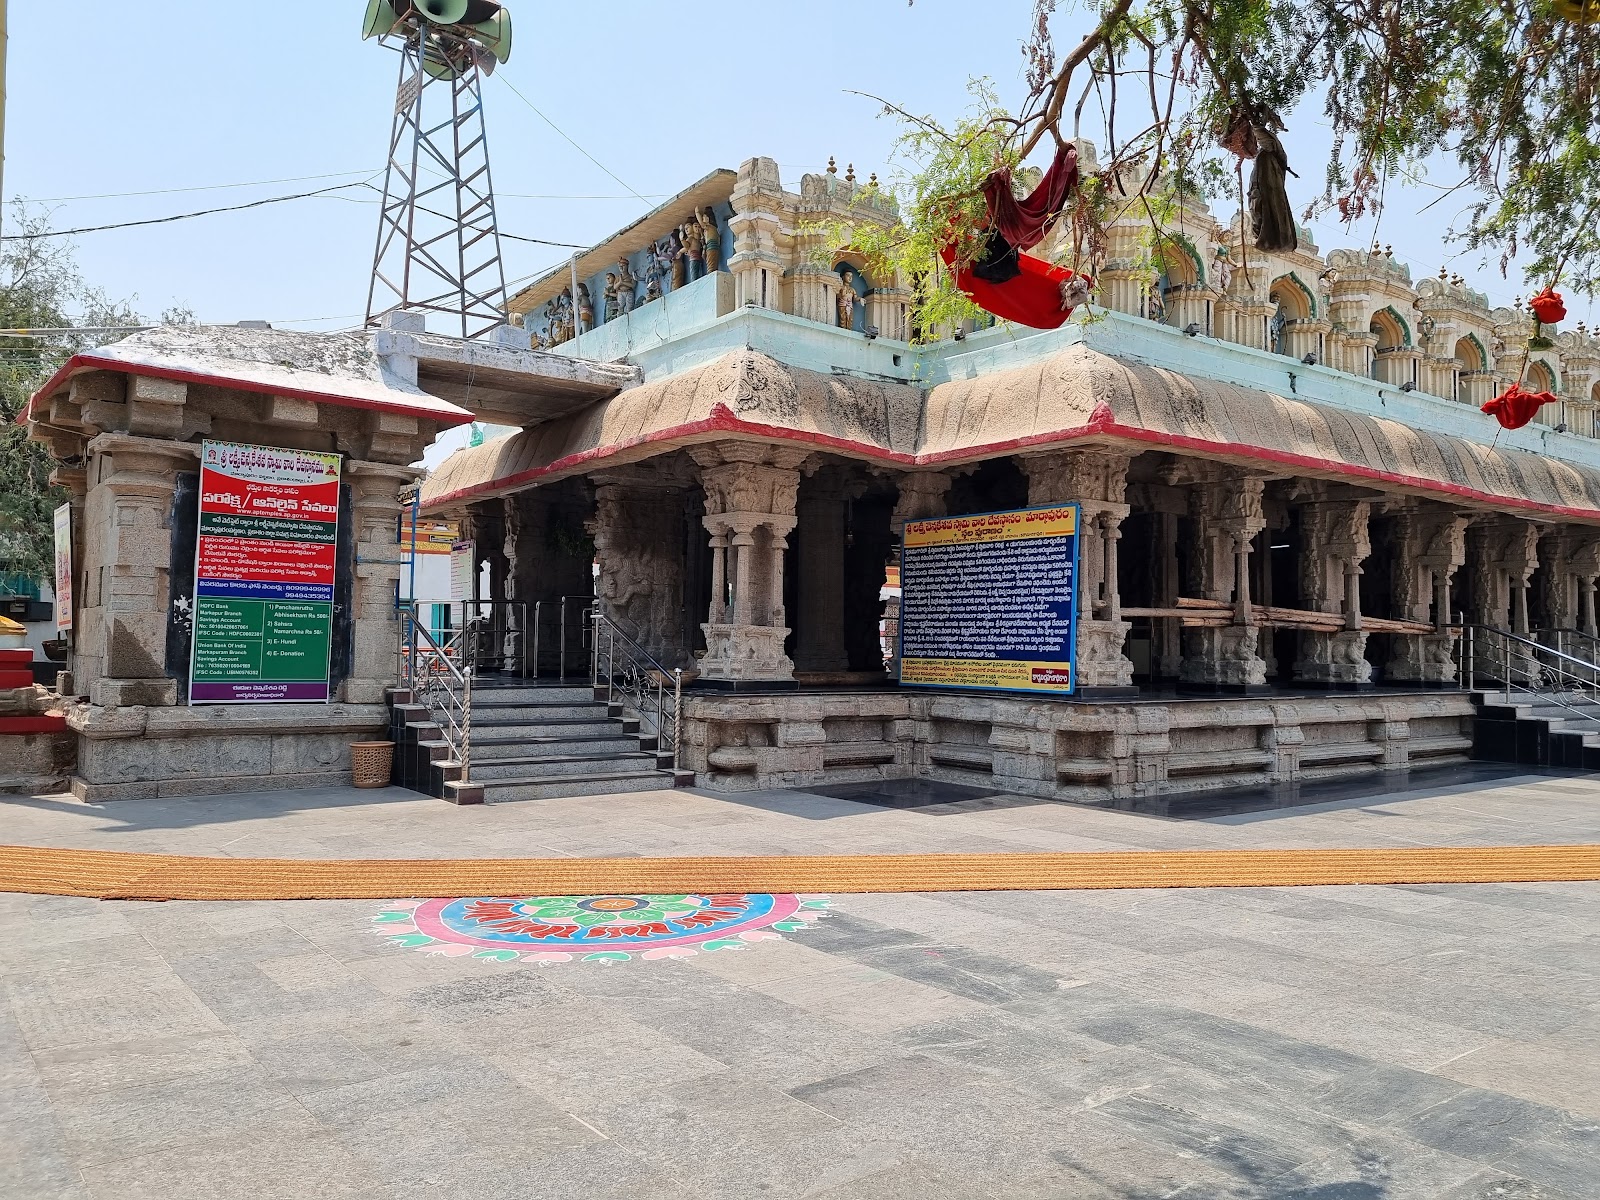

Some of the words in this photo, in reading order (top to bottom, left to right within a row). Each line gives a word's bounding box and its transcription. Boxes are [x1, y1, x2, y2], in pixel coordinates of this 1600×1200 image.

[284, 459, 295, 471] వారి
[203, 492, 242, 509] పరోక్ష
[301, 499, 337, 514] సేవలు
[237, 508, 310, 520] www.aptemples.ap.gov.in
[953, 519, 970, 532] స్వామి
[971, 517, 986, 528] వారి
[988, 513, 1021, 528] దేవస్థానం
[975, 527, 1003, 539] పురాణం
